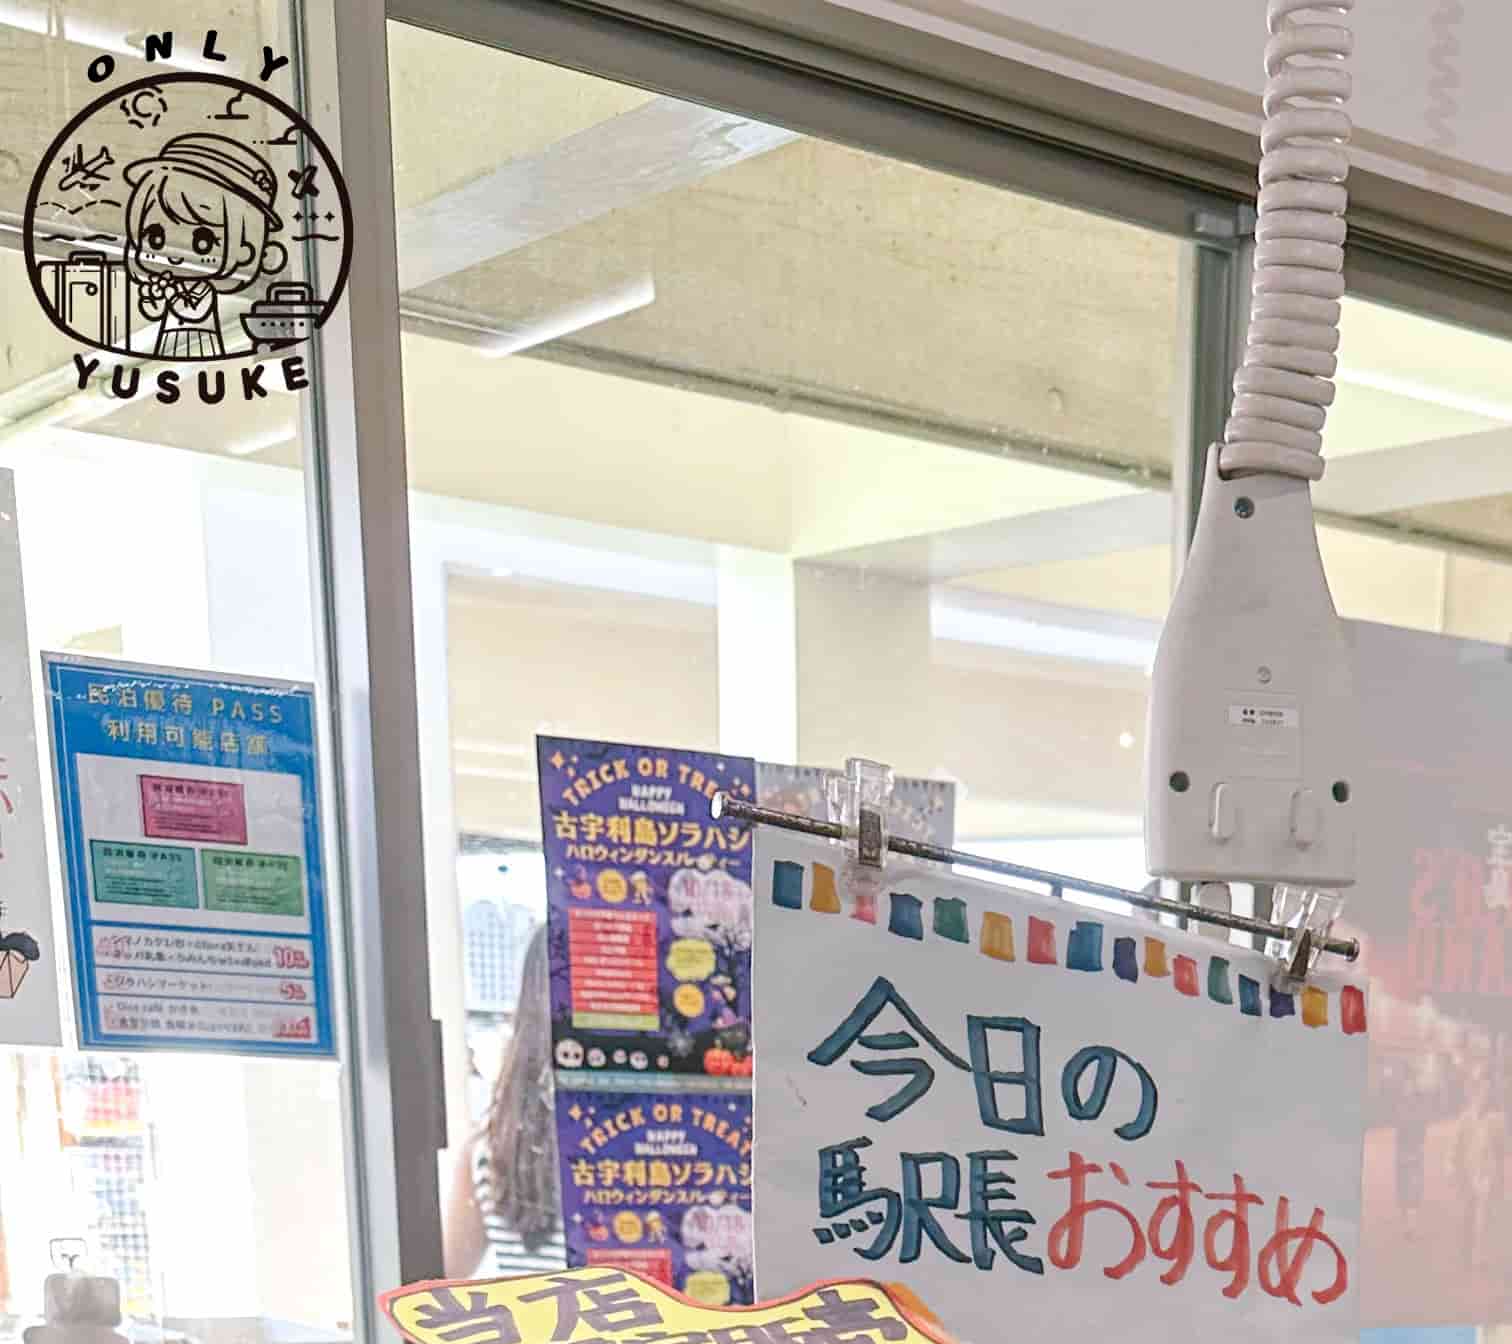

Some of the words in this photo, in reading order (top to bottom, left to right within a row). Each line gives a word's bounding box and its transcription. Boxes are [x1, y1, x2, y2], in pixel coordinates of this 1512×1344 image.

[210, 698, 283, 723] PASS
[562, 759, 630, 807] TRICK
[637, 757, 669, 779] OR
[678, 763, 719, 800] TRE
[553, 810, 750, 851] 古宇利島ソラハシ
[807, 975, 1158, 1141] 今日の
[652, 1103, 683, 1123] OR
[813, 1136, 1348, 1306] 駅長おすすめ
